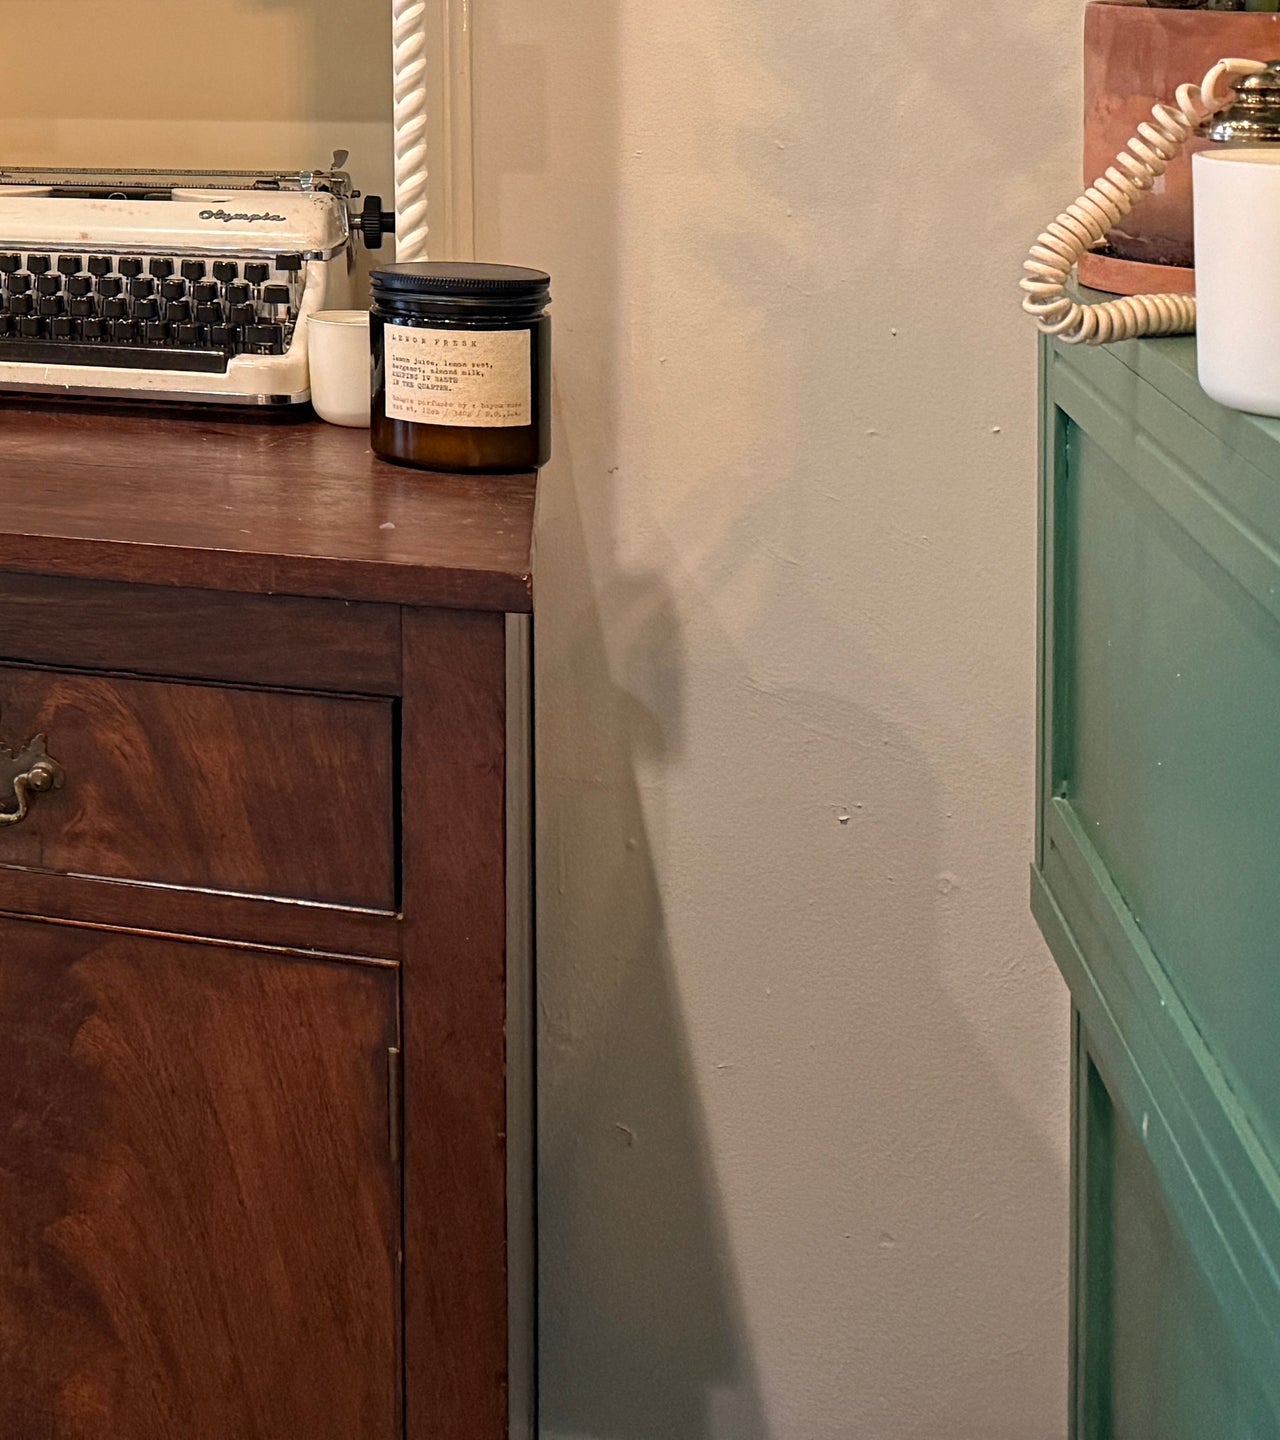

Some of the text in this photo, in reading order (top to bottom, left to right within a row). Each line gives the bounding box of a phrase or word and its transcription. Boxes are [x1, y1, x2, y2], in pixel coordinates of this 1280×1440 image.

[199, 209, 287, 222] Olympia
[392, 354, 410, 364] lemon
[414, 358, 438, 367] juice,
[430, 367, 458, 375] almond
